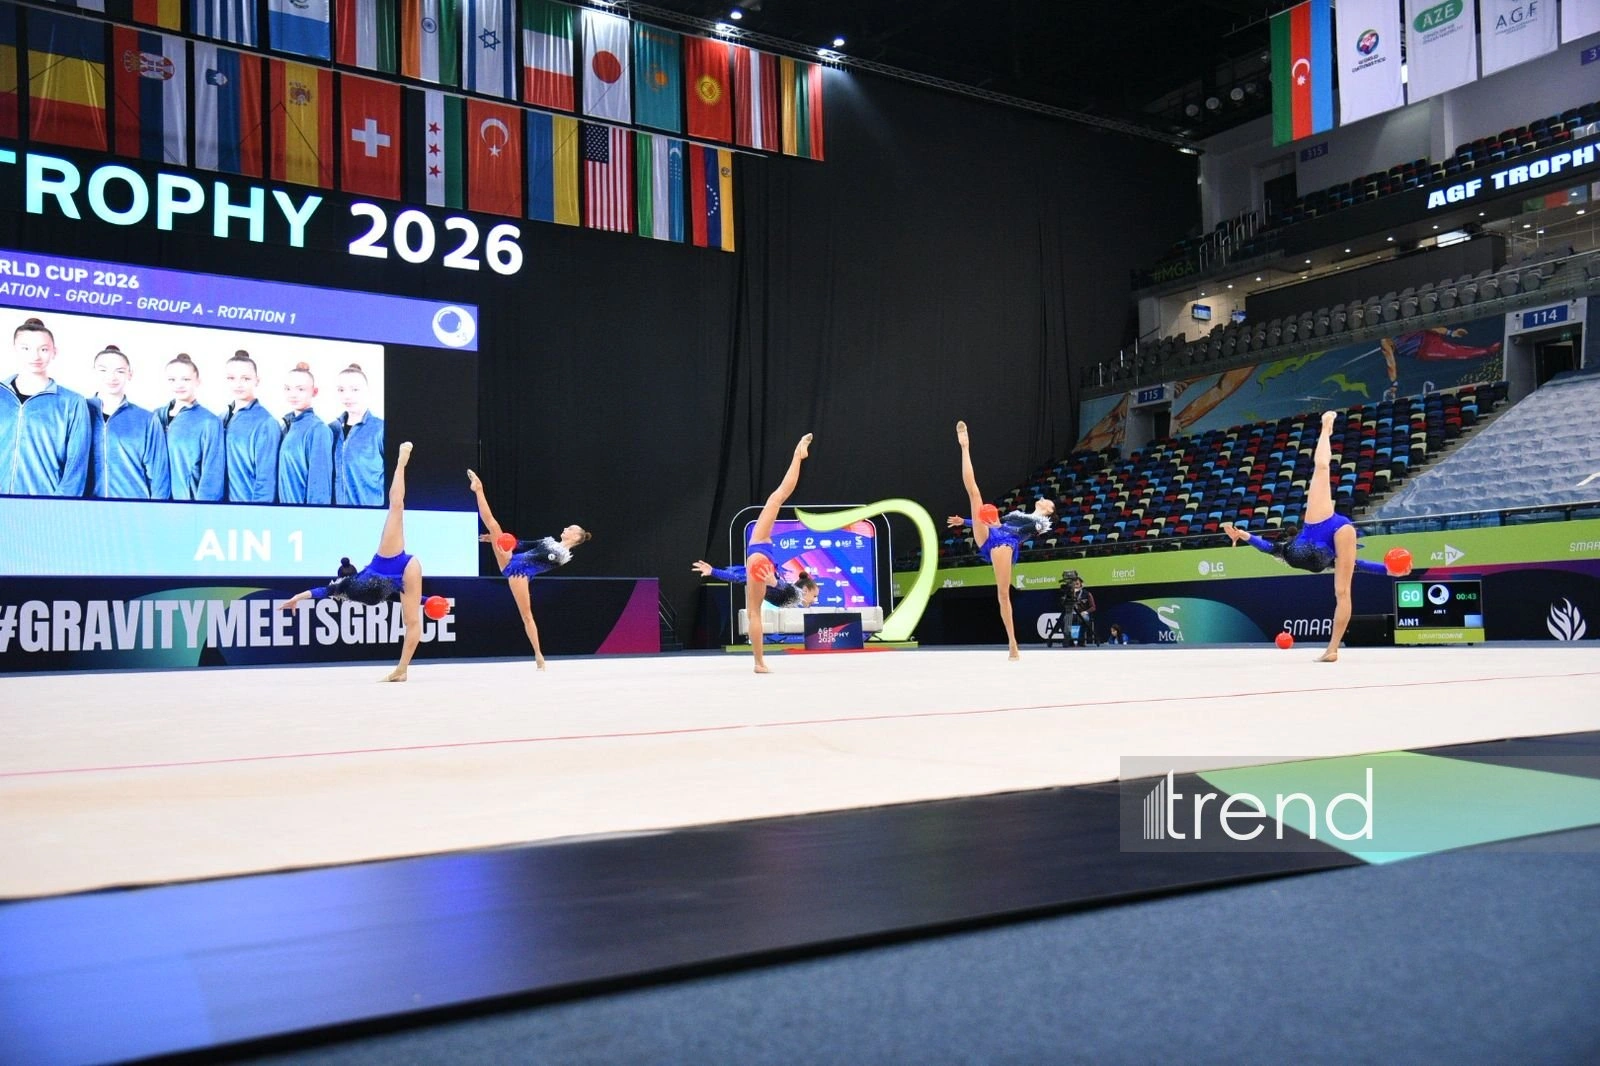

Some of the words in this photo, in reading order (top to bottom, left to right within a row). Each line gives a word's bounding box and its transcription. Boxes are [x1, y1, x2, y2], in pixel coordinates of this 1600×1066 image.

[1422, 3, 1455, 29] AZE
[1495, 1, 1538, 30] AGF
[1427, 178, 1482, 209] AGF
[0, 149, 323, 248] ROPHY
[348, 202, 524, 276] 2026
[45, 264, 88, 283] CUP
[93, 270, 140, 289] 2026
[65, 289, 123, 307] GROUP
[136, 296, 191, 314] GROUP
[192, 303, 203, 316] A
[217, 305, 286, 324] ROTATION
[289, 313, 297, 324] 1
[1533, 309, 1557, 325] 114
[1143, 390, 1159, 401] 115
[193, 528, 272, 562] AIN
[288, 529, 303, 562] 1
[1113, 568, 1136, 578] trend
[1211, 561, 1224, 573] LG
[1401, 590, 1421, 602] GO
[817, 627, 833, 635] AGF
[818, 631, 850, 639] TROPHY
[1283, 619, 1334, 636] SMAR
[1158, 630, 1184, 642] MGA
